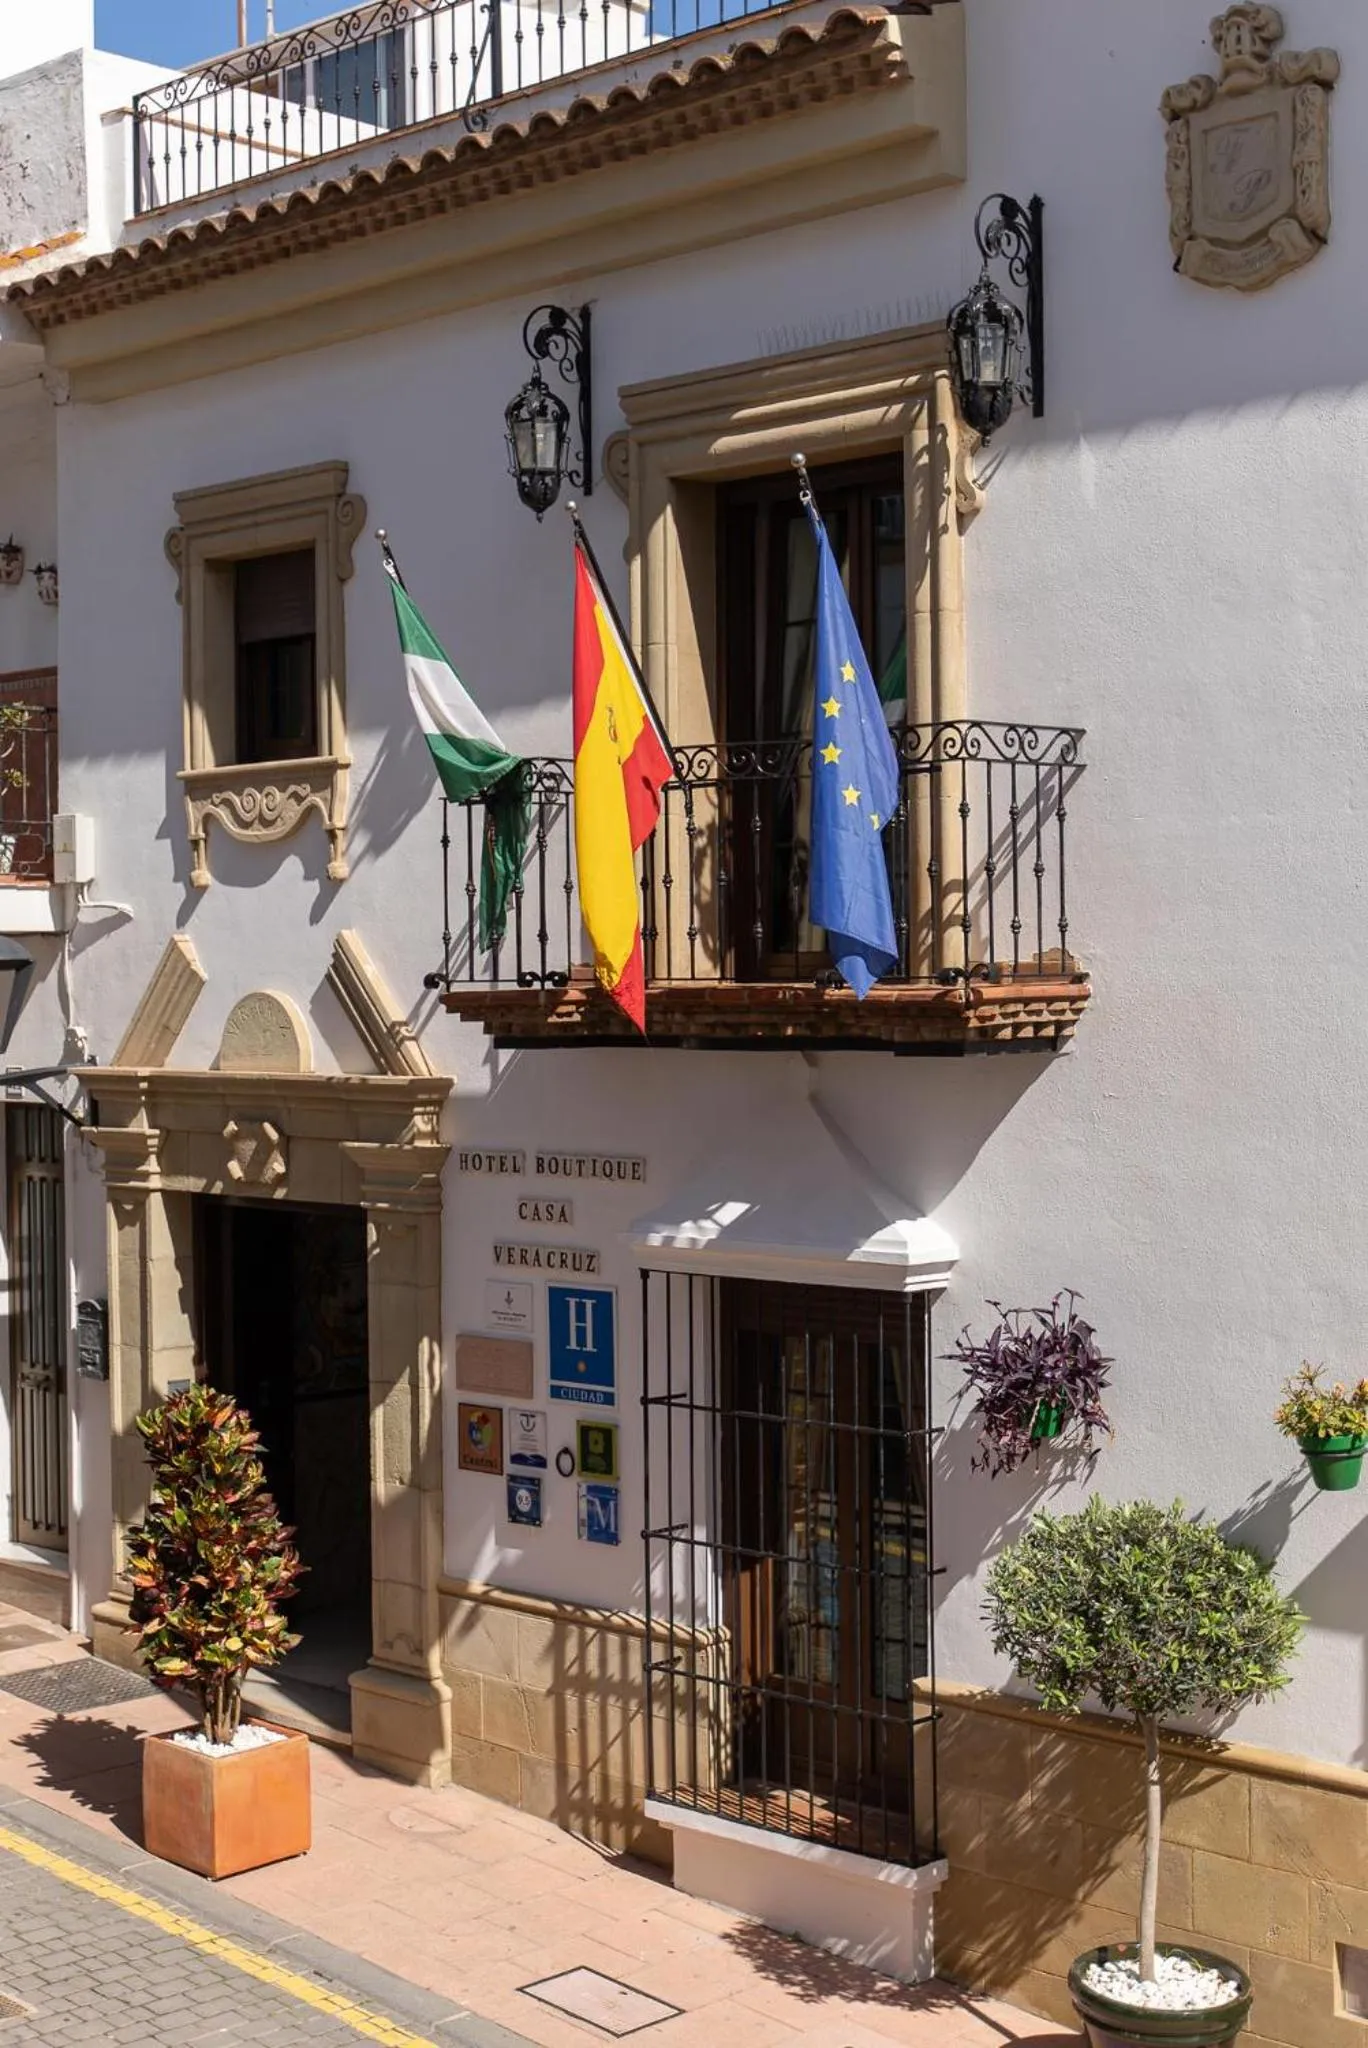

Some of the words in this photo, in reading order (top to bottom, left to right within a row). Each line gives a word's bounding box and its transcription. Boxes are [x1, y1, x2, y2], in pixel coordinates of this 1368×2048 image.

[459, 1153, 521, 1173] HOTEL
[535, 1156, 641, 1181] BOUTIQUE
[518, 1202, 568, 1223] CASA
[493, 1245, 597, 1273] VERACRUZ
[564, 1297, 598, 1352] H
[560, 1387, 605, 1404] CIUDAD
